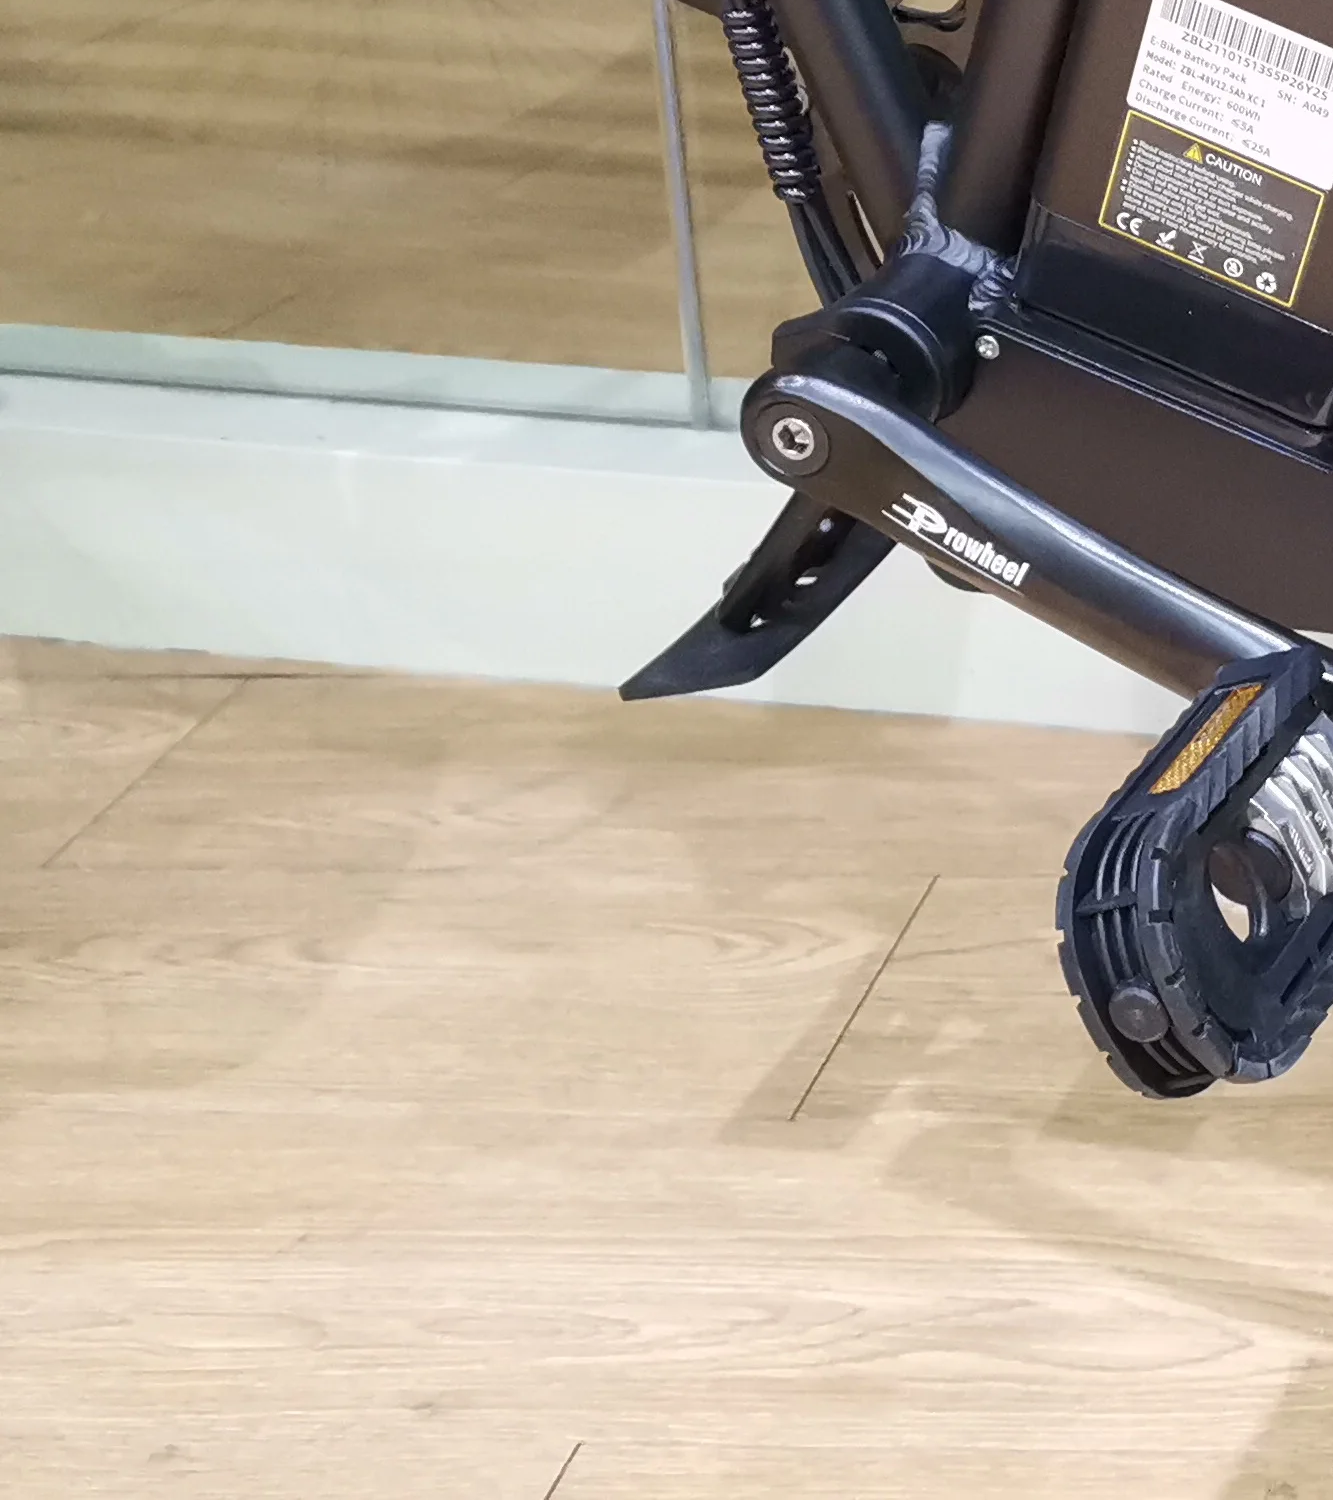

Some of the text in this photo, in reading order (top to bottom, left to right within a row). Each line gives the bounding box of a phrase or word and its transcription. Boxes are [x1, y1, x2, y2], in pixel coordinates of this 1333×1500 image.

[1145, 49, 1177, 70] Model:
[1149, 34, 1182, 56] E-Bike
[1182, 49, 1221, 75] Battery
[1222, 66, 1248, 84] Pack
[1301, 99, 1330, 119] A049
[1134, 91, 1188, 122] Discharge
[1137, 77, 1177, 103] Charge
[1177, 94, 1225, 122] Current:
[1141, 63, 1262, 122] Rated Energy: 600Wh
[1204, 151, 1263, 186] CAUTION
[1115, 210, 1144, 237] CE
[881, 492, 1030, 590] Prowheel
